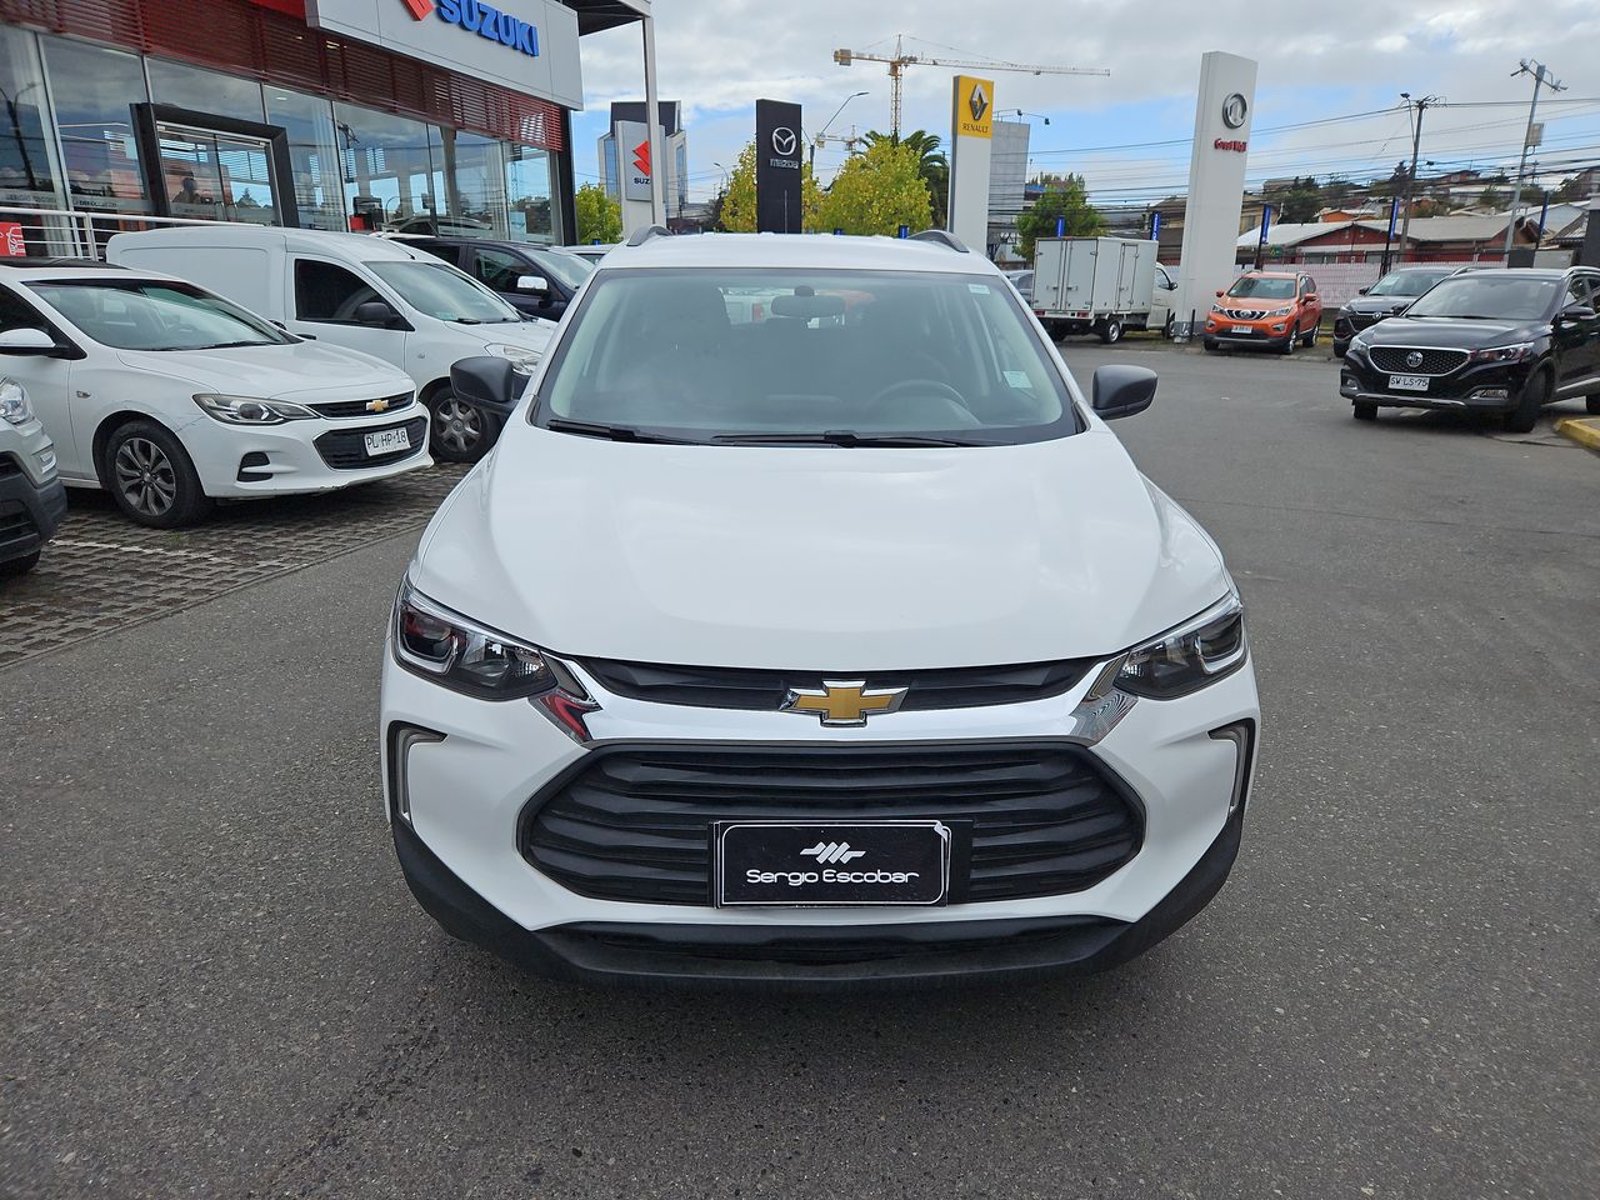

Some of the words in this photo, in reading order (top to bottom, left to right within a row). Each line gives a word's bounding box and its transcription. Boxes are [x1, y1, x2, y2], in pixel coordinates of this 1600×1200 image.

[436, 0, 539, 57] SUZUKI
[634, 177, 651, 185] SUZ
[746, 869, 819, 886] Sergio
[822, 869, 920, 884] Escobar
